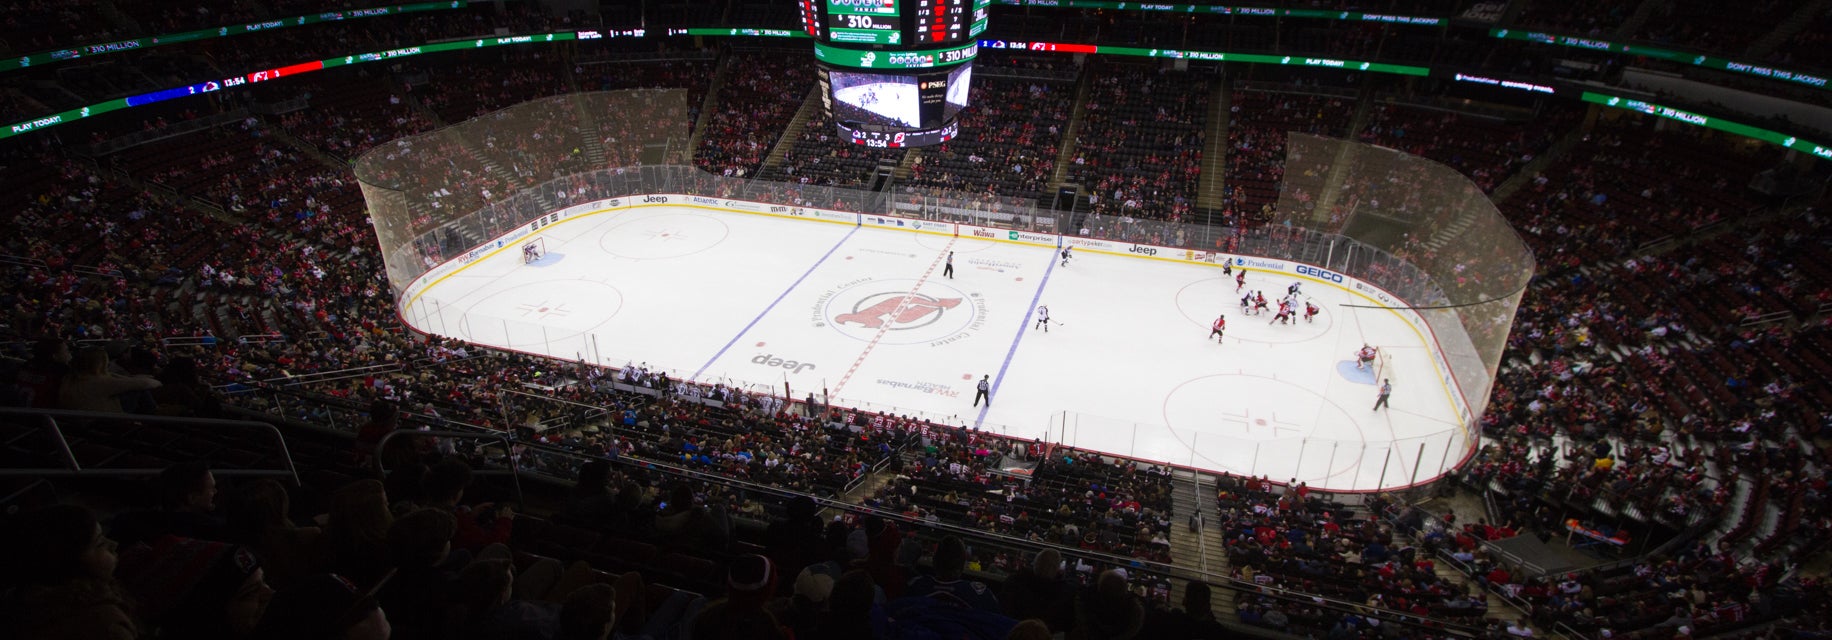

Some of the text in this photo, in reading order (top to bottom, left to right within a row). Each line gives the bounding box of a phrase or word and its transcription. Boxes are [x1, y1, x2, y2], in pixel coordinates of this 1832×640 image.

[848, 15, 872, 29] 310
[1411, 17, 1439, 25] JACKPOT
[92, 41, 139, 53] 310 MILLION
[1579, 39, 1610, 49] MILLION
[397, 47, 420, 56] MILLION
[946, 51, 961, 62] 310
[961, 44, 978, 59] MILLIO
[1726, 62, 1828, 87] DON'T MISS THIS JACKPOT
[224, 77, 245, 87] 13:54
[928, 81, 946, 89] PSEG
[188, 86, 195, 94] 2
[1676, 110, 1708, 125] MILLION
[12, 115, 61, 133] PLAY TODAY!
[866, 139, 887, 147] 13:54
[643, 194, 667, 204] Jeep
[973, 229, 995, 238] Wawa
[1128, 243, 1157, 256] Jeep
[1247, 259, 1284, 271] Prudential
[1296, 264, 1343, 284] GEICO
[837, 276, 874, 289] Center
[931, 333, 970, 348] Center
[751, 353, 816, 374] Jeep
